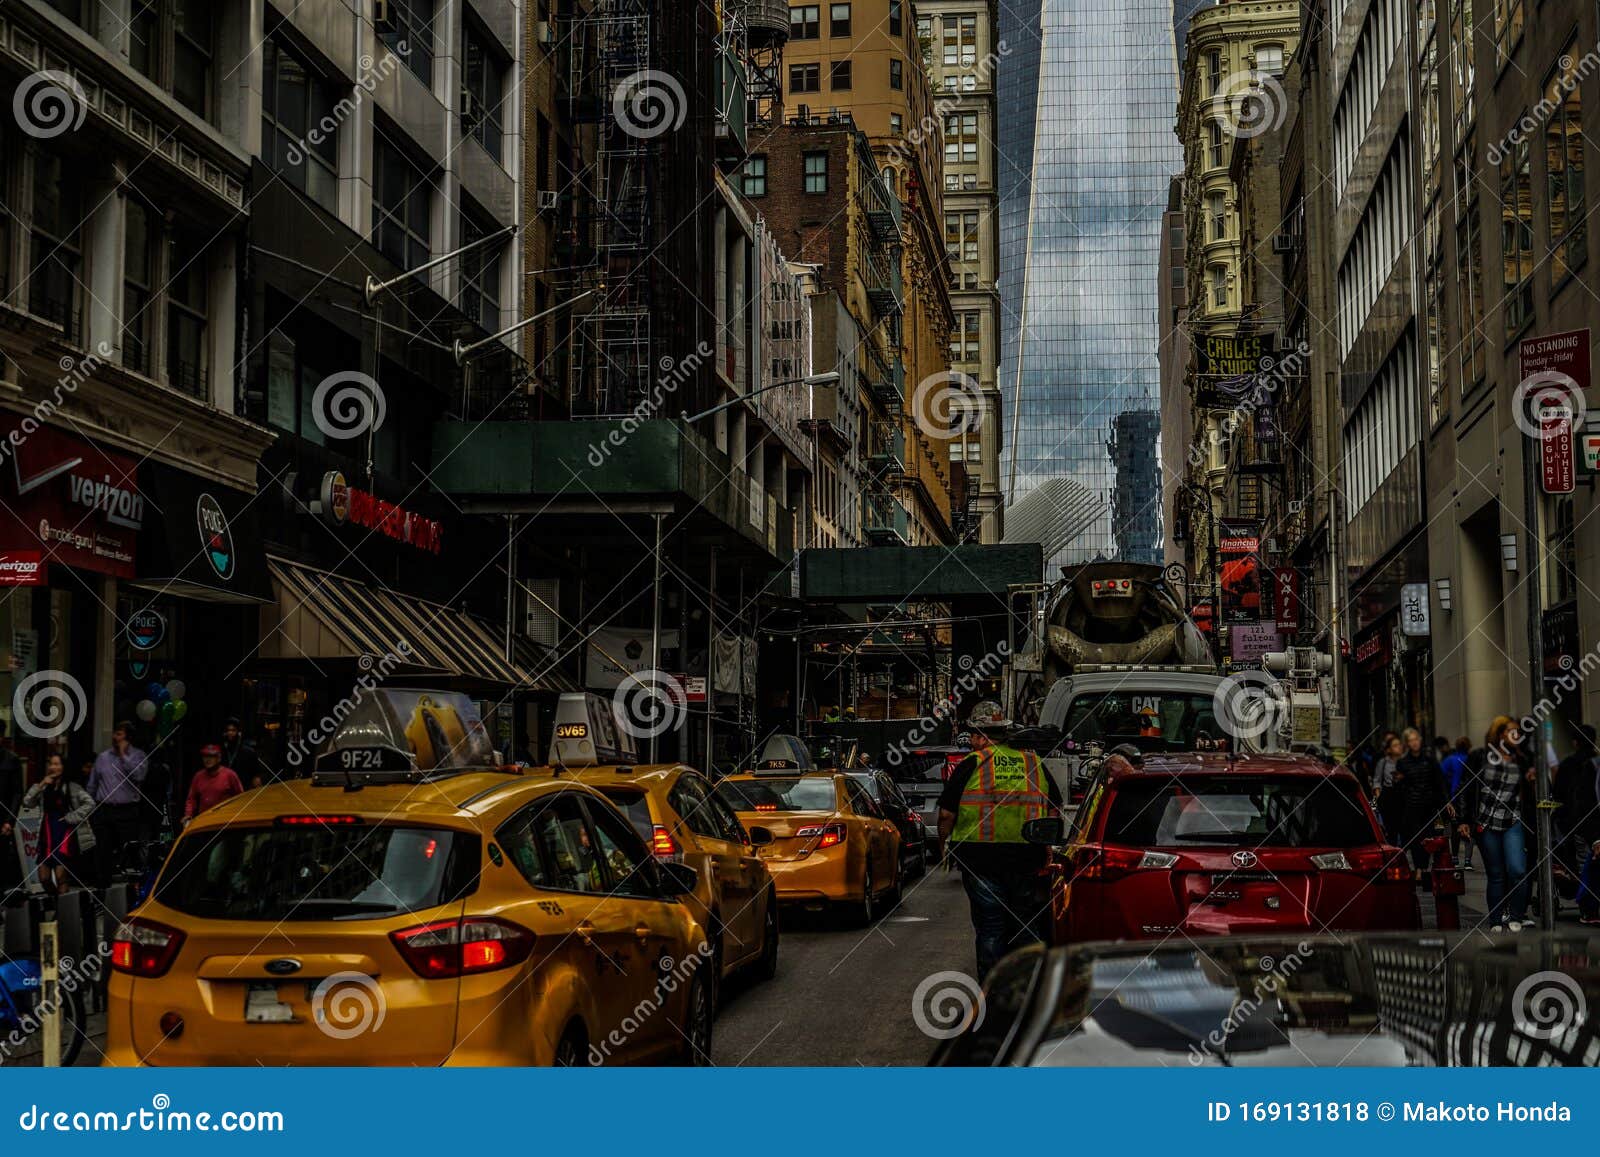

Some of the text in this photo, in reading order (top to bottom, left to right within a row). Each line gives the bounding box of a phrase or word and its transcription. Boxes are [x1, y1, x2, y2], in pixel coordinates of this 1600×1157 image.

[1206, 337, 1261, 359] CABLES
[1523, 336, 1578, 356] NO STANDING
[1524, 356, 1548, 368] Monday
[1553, 351, 1575, 363] Friday
[71, 474, 144, 531] verizon
[1132, 695, 1161, 714] CAT
[557, 724, 586, 737] 3V65
[341, 750, 383, 769] 9F24
